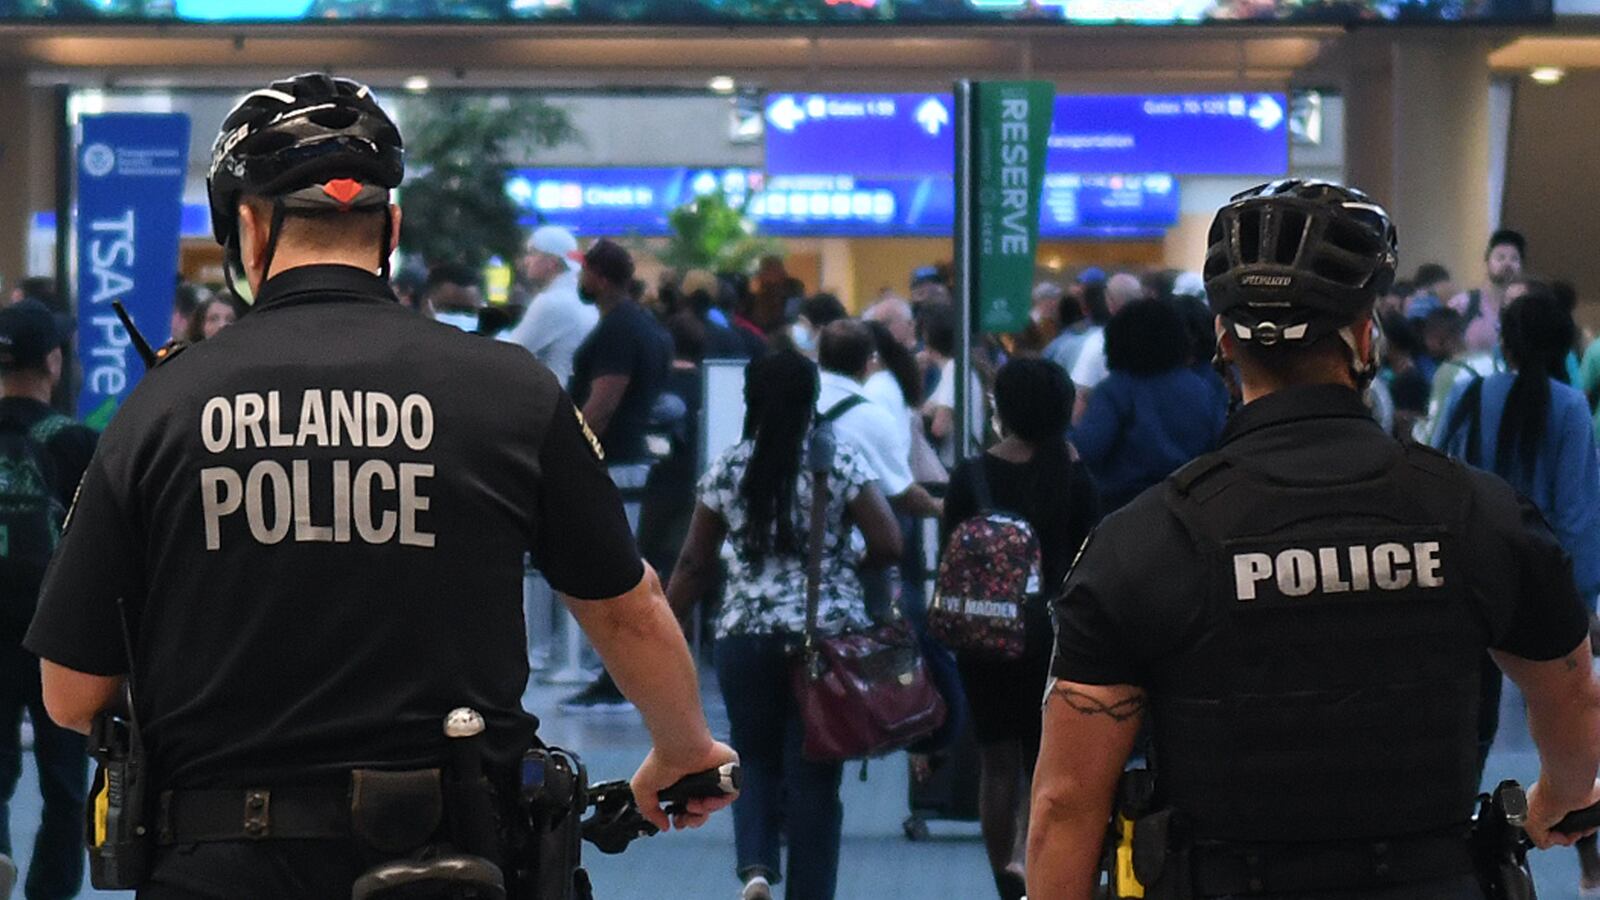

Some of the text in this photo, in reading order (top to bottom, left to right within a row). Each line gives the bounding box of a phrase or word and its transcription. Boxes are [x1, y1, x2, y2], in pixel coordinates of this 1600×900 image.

[1001, 98, 1029, 255] RESERVE
[1047, 134, 1135, 149] ransportation
[91, 209, 135, 304] TSA
[91, 313, 135, 396] Pre
[201, 388, 434, 453] ORLANDO
[200, 459, 436, 550] POLICE
[1233, 541, 1445, 600] POLICE
